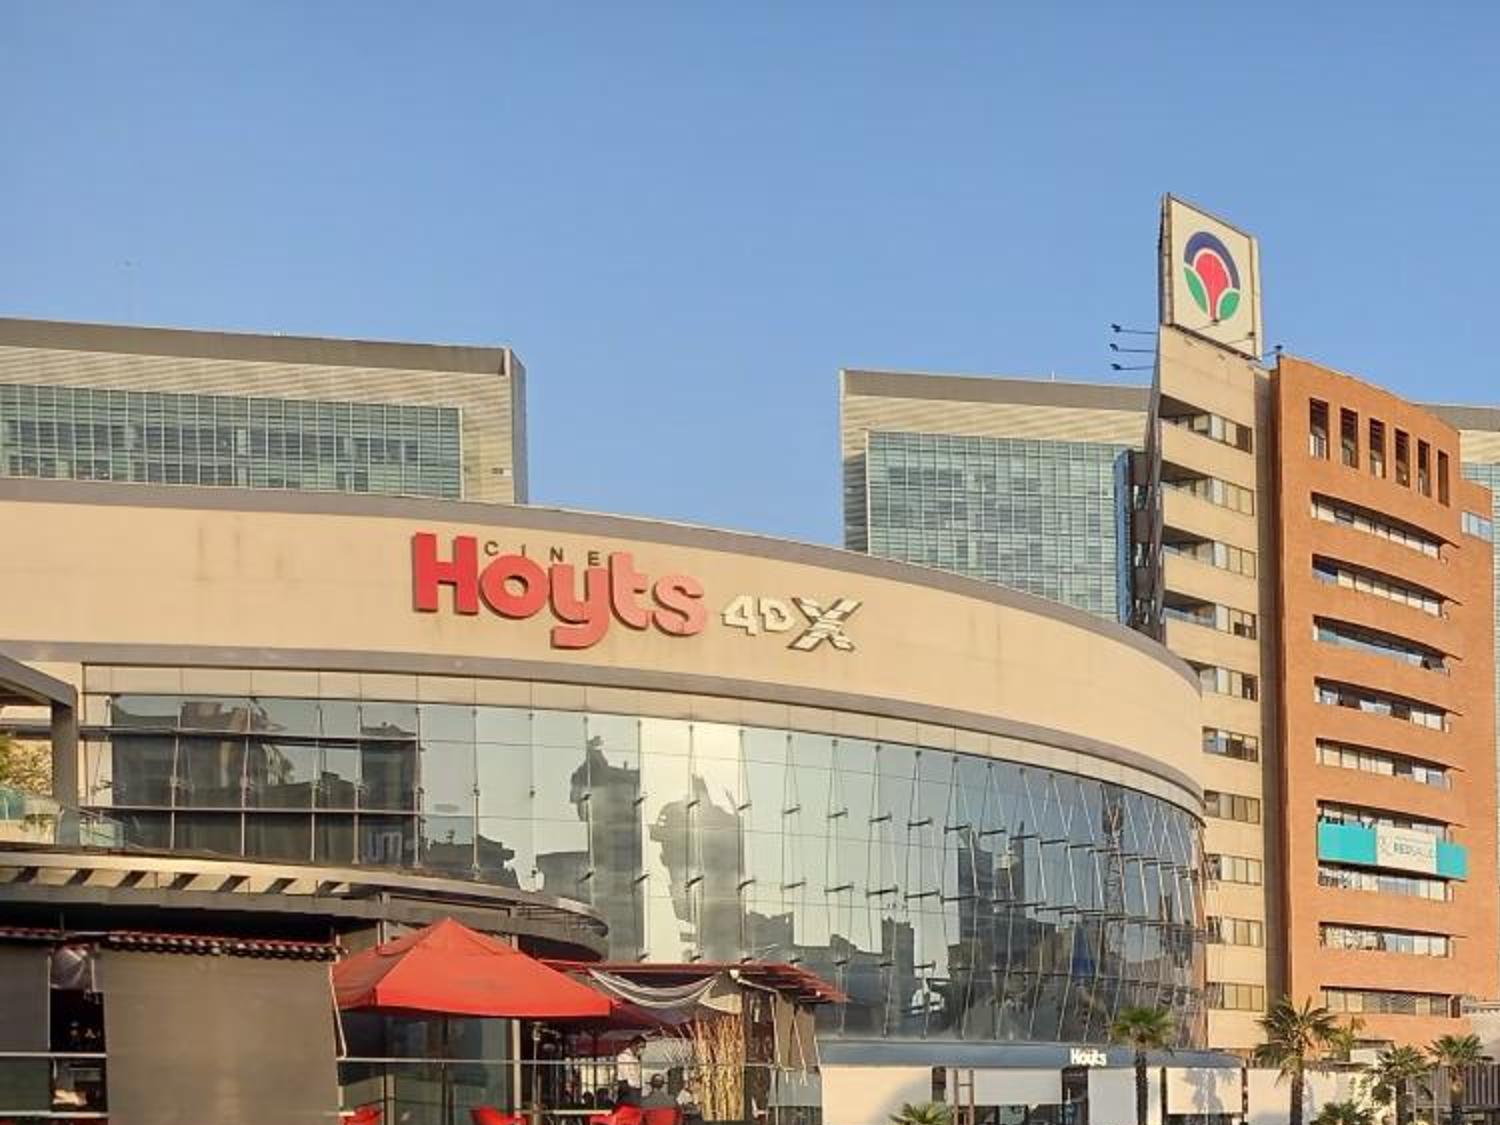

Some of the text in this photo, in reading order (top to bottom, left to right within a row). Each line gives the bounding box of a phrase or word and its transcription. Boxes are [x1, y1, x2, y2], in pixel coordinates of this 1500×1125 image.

[484, 541, 600, 566] CINE
[411, 532, 864, 652] Hoyts 4DX
